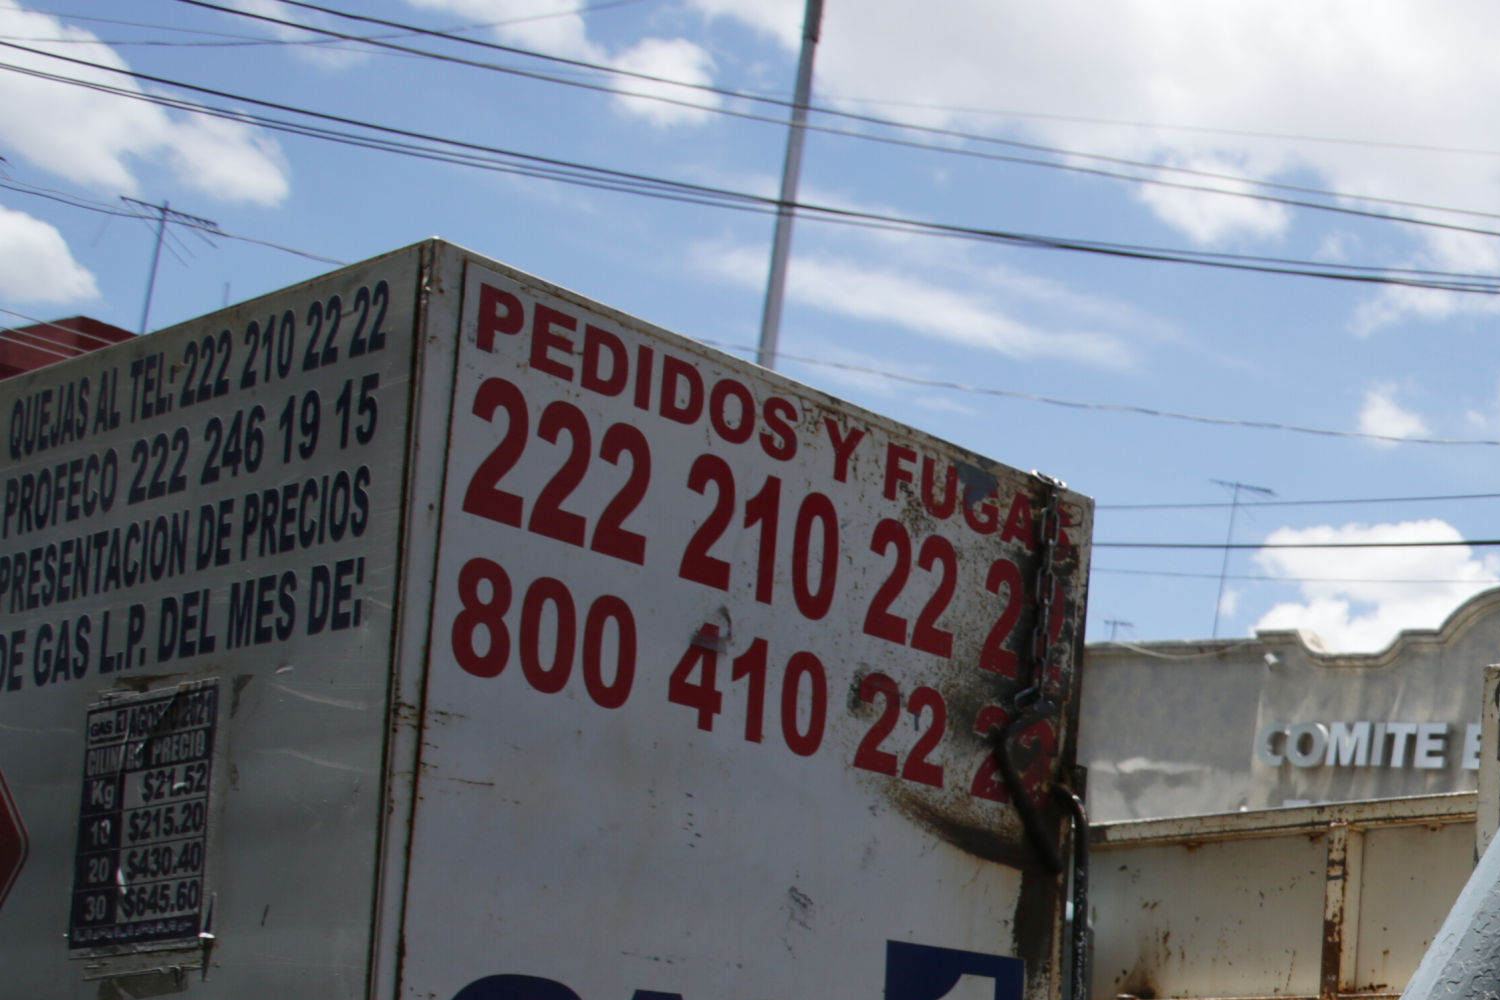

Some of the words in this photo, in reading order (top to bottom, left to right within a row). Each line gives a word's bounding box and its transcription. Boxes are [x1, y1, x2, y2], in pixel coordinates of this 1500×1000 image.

[9, 377, 90, 461] QUEJAS
[93, 366, 121, 436] AL
[130, 352, 174, 424] TEL:
[180, 328, 232, 408] 222
[240, 309, 295, 390] 210
[302, 295, 342, 371] 22
[348, 280, 389, 358] 22
[475, 282, 799, 462] PEDIDOS
[823, 417, 867, 483] Y
[3, 447, 118, 538] PROFECO
[127, 426, 190, 505] 222
[200, 404, 265, 485] 246
[278, 389, 320, 464] 19
[336, 372, 380, 449] 15
[0, 510, 190, 614] PRESENTACION
[196, 498, 234, 571] DE
[240, 465, 370, 561] PRECIOS
[462, 377, 652, 567] 222
[678, 453, 839, 621] 210
[863, 518, 958, 659] 22
[34, 613, 91, 686] GAS
[99, 603, 146, 674] L.P.
[157, 588, 216, 662] DEL
[226, 570, 297, 649] MES
[450, 556, 637, 710] 800
[667, 623, 828, 758] 410
[852, 671, 947, 788] 22
[91, 720, 113, 737] GAS
[151, 730, 207, 766] PRECIO
[1256, 721, 1448, 769] COMITE
[91, 780, 115, 811] Kg
[128, 802, 204, 843] $215.20
[85, 895, 107, 922] 30
[122, 879, 199, 919] $645.60
[88, 857, 110, 884] 20
[126, 844, 201, 883] $430.40
